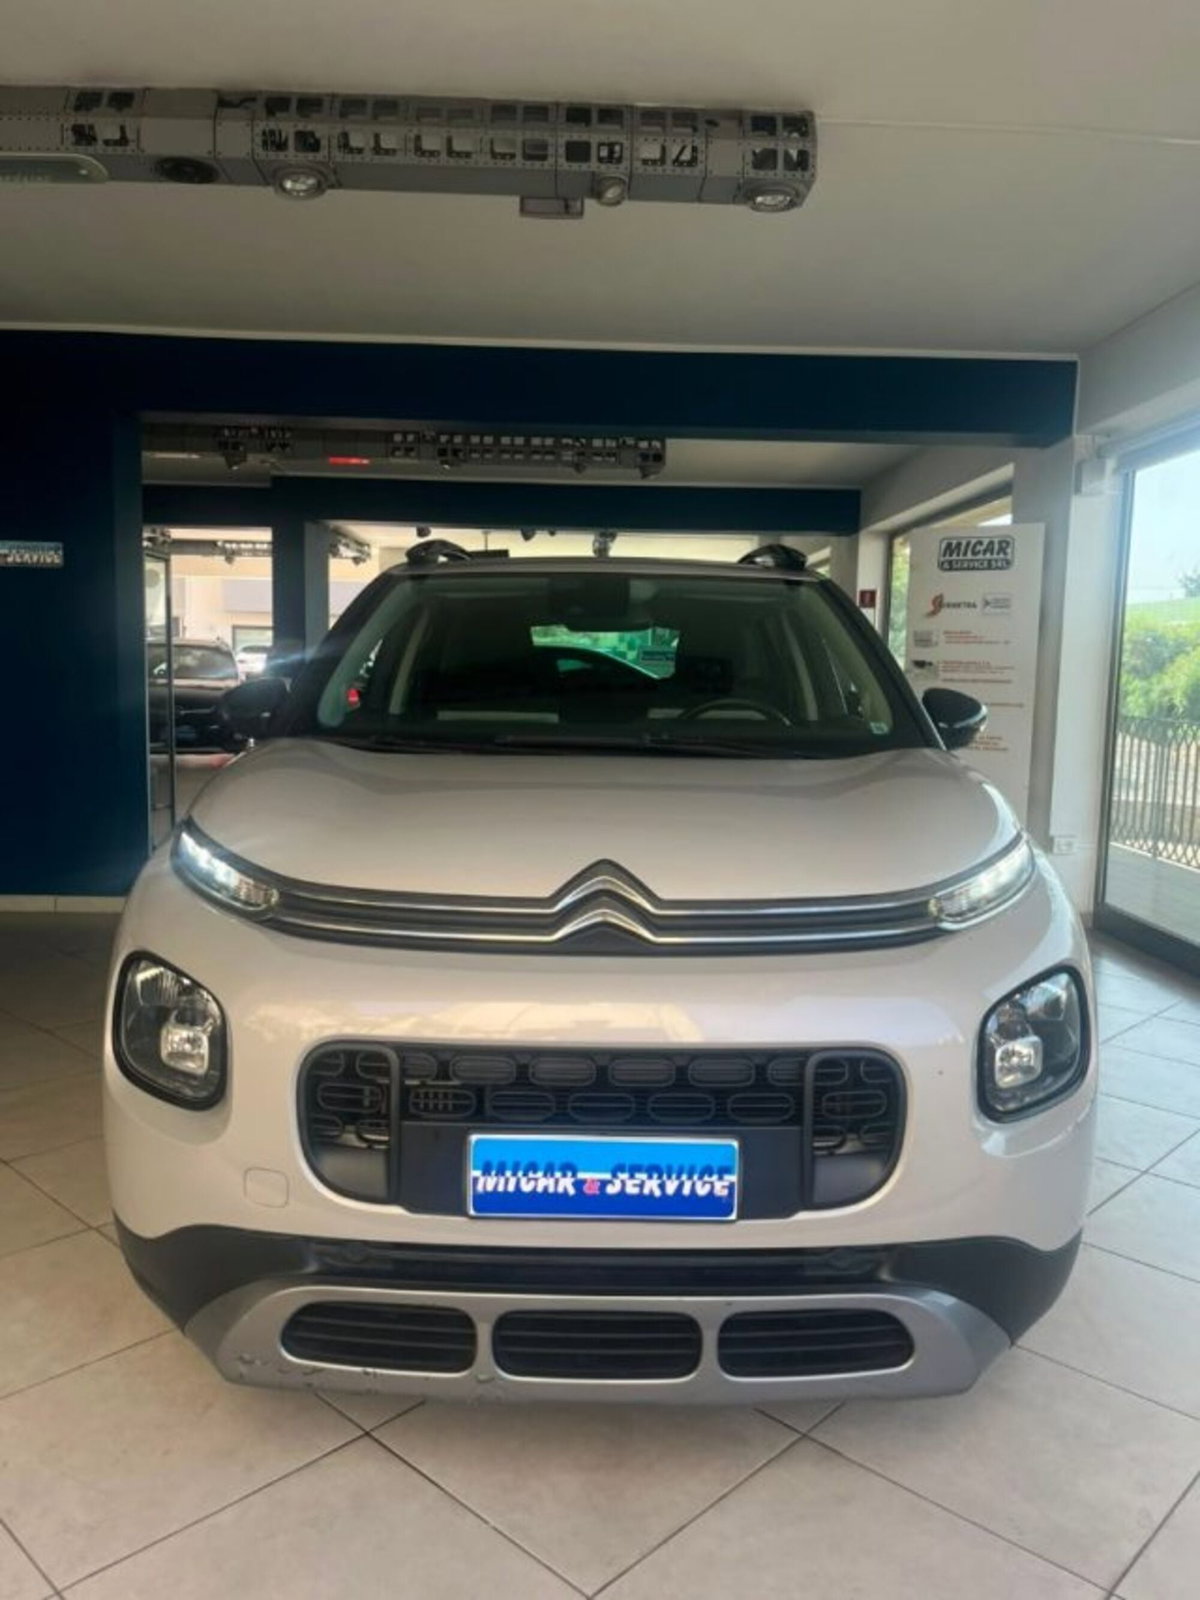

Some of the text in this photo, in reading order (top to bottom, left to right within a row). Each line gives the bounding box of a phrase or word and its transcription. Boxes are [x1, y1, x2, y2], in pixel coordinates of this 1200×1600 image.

[942, 540, 1010, 558] MICAR
[477, 1161, 732, 1198] MICAR & SERVICE
